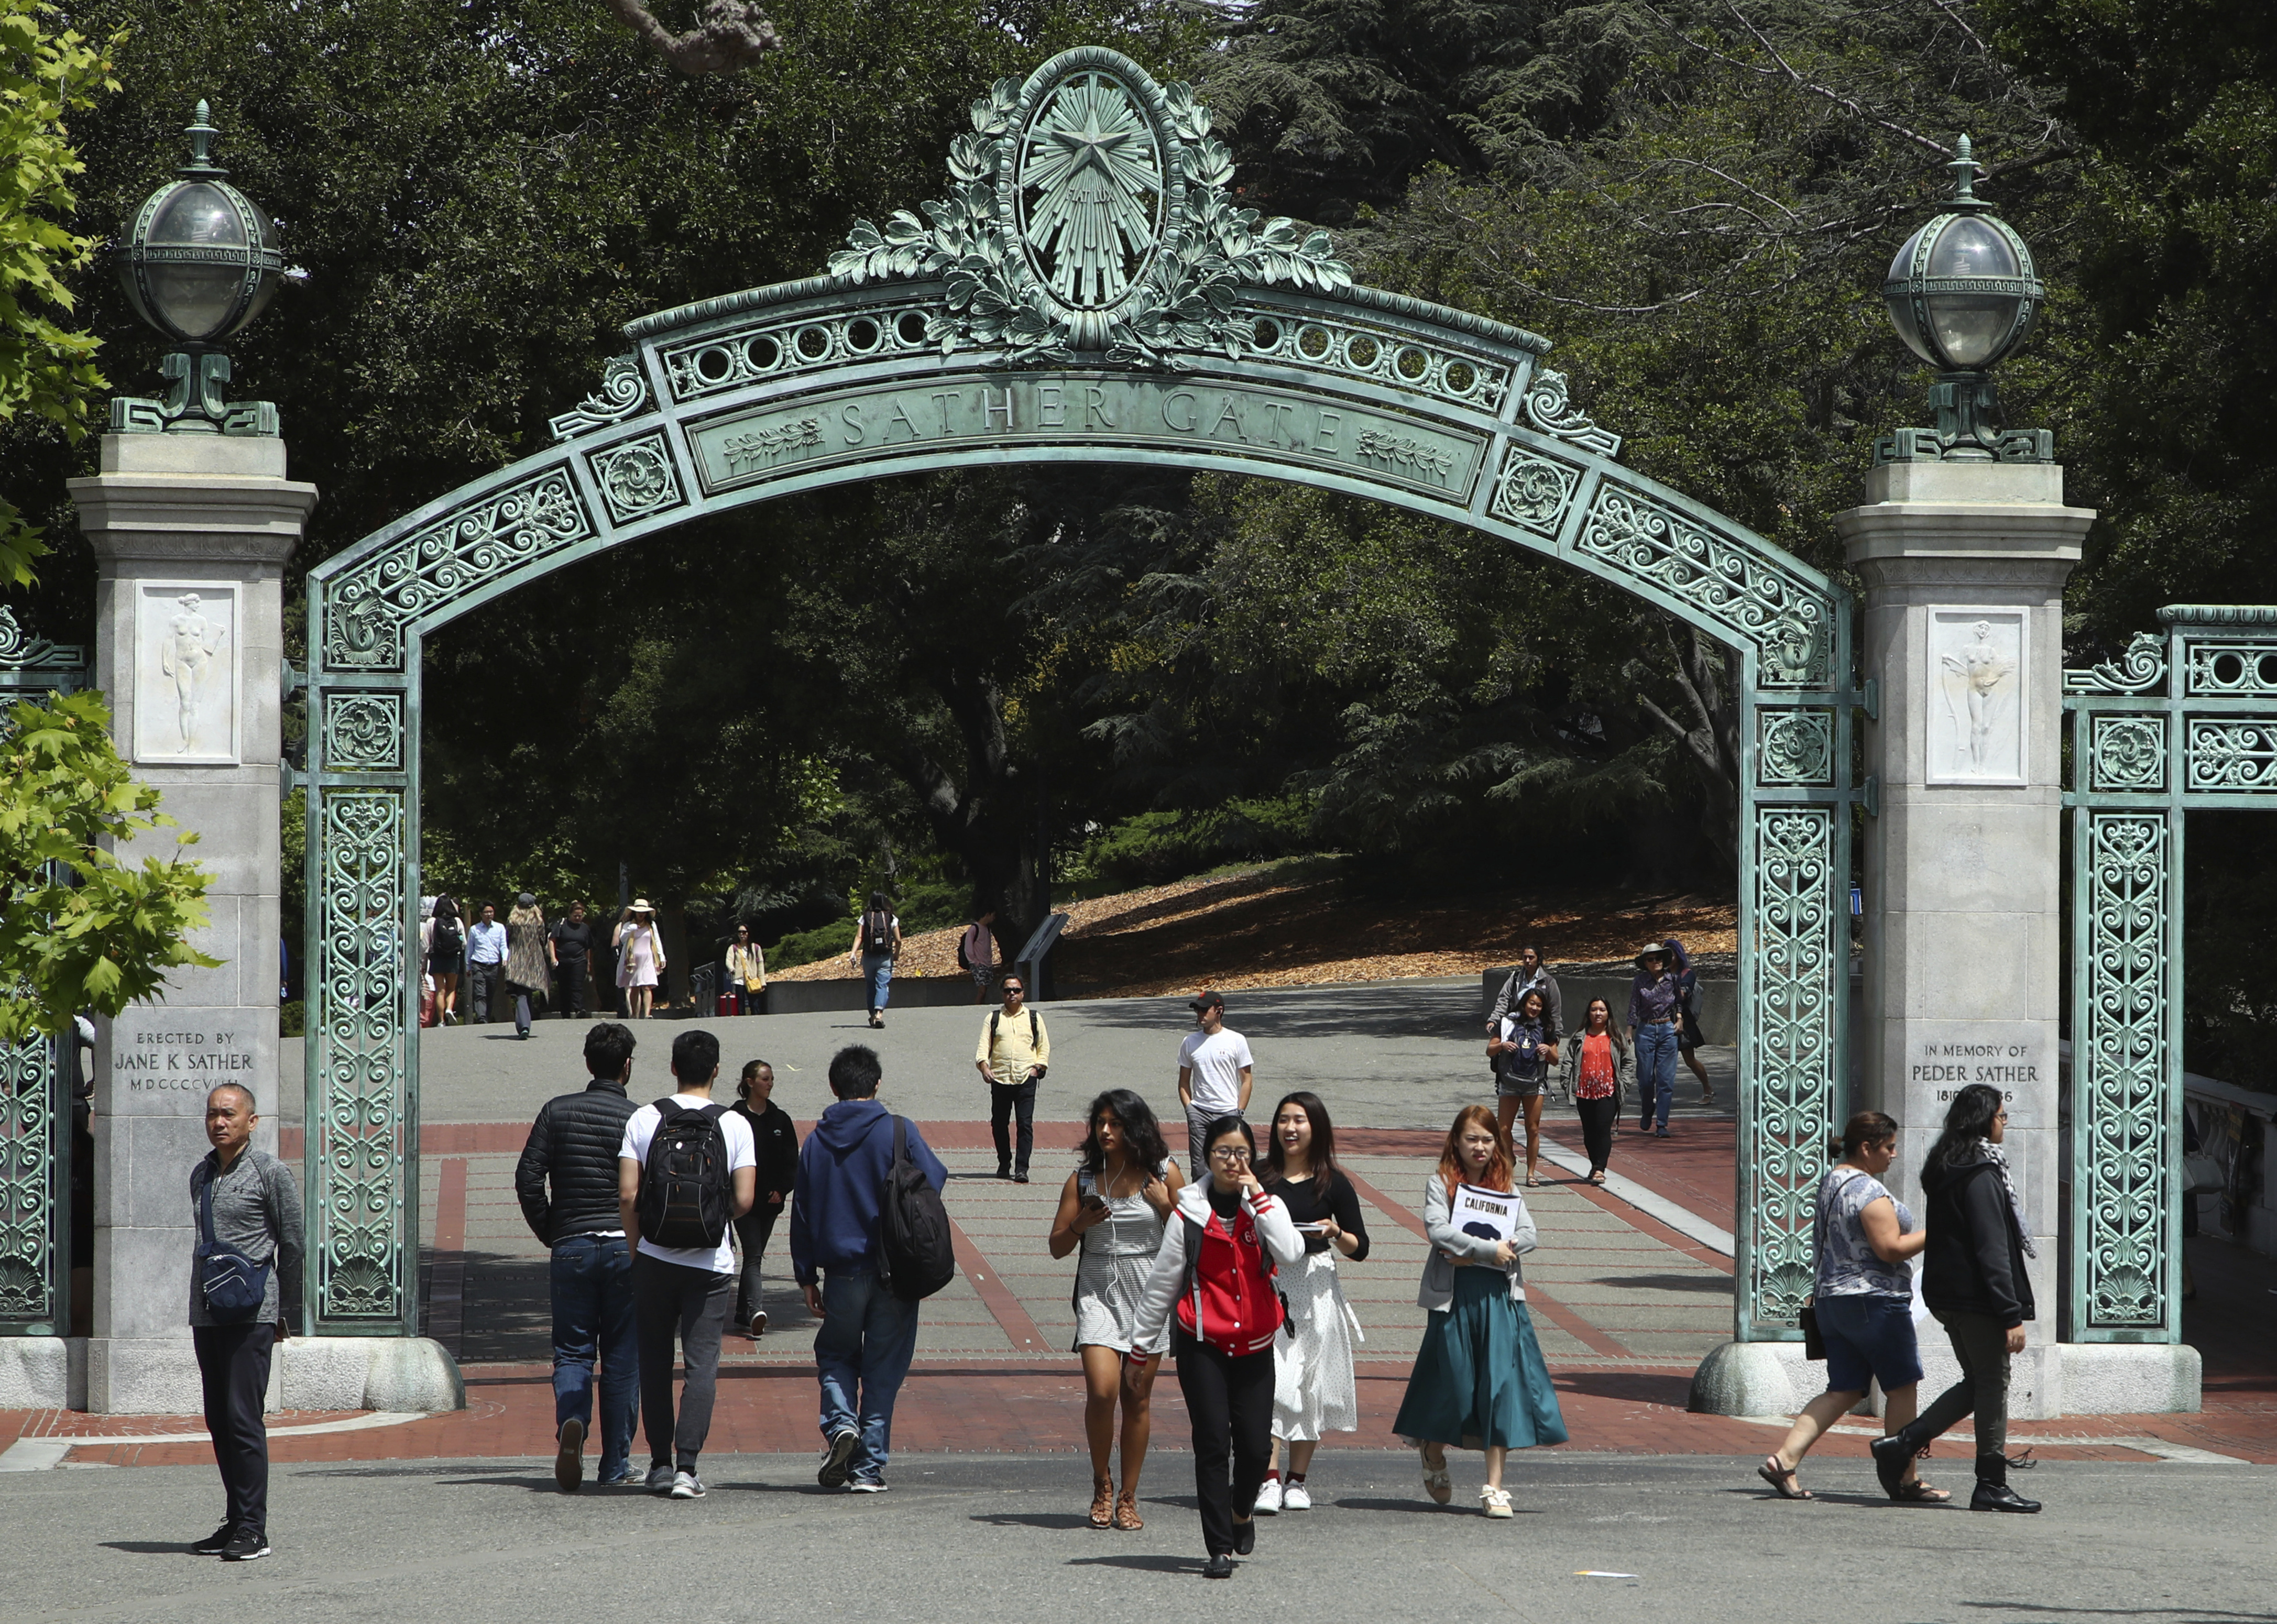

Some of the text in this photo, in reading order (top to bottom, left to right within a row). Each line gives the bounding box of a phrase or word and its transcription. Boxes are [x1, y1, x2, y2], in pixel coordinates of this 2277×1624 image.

[841, 386, 1341, 454] SATHER GATE
[137, 1033, 235, 1045] ERECTED BY
[1924, 1045, 2028, 1057] IN MEMORY OF
[115, 1053, 254, 1070] JANE K SATHER
[1912, 1065, 2040, 1082] PEDER SATHER
[1465, 1198, 1507, 1216] CALIFORNIA
